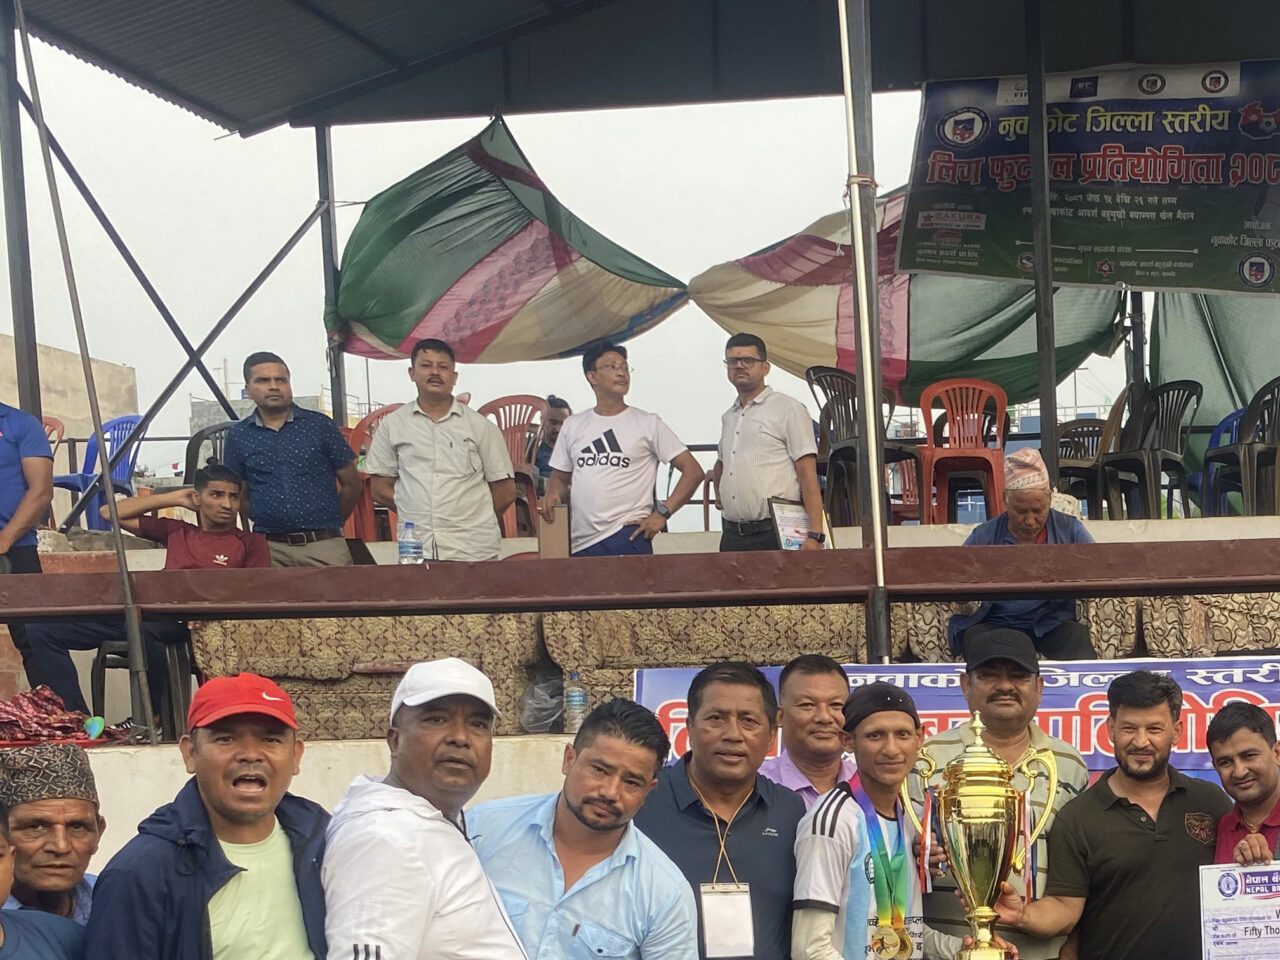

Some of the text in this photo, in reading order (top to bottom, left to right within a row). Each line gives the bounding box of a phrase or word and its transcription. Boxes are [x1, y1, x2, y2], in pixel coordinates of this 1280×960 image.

[1085, 105, 1155, 133] जिल्ला
[1161, 103, 1231, 134] स्तरीय
[1079, 143, 1225, 185] प्रतियोगिता
[577, 453, 631, 468] adidas
[1245, 874, 1269, 884] नेपाल
[1245, 885, 1269, 894] NEPAL
[1244, 925, 1262, 939] Fifty
